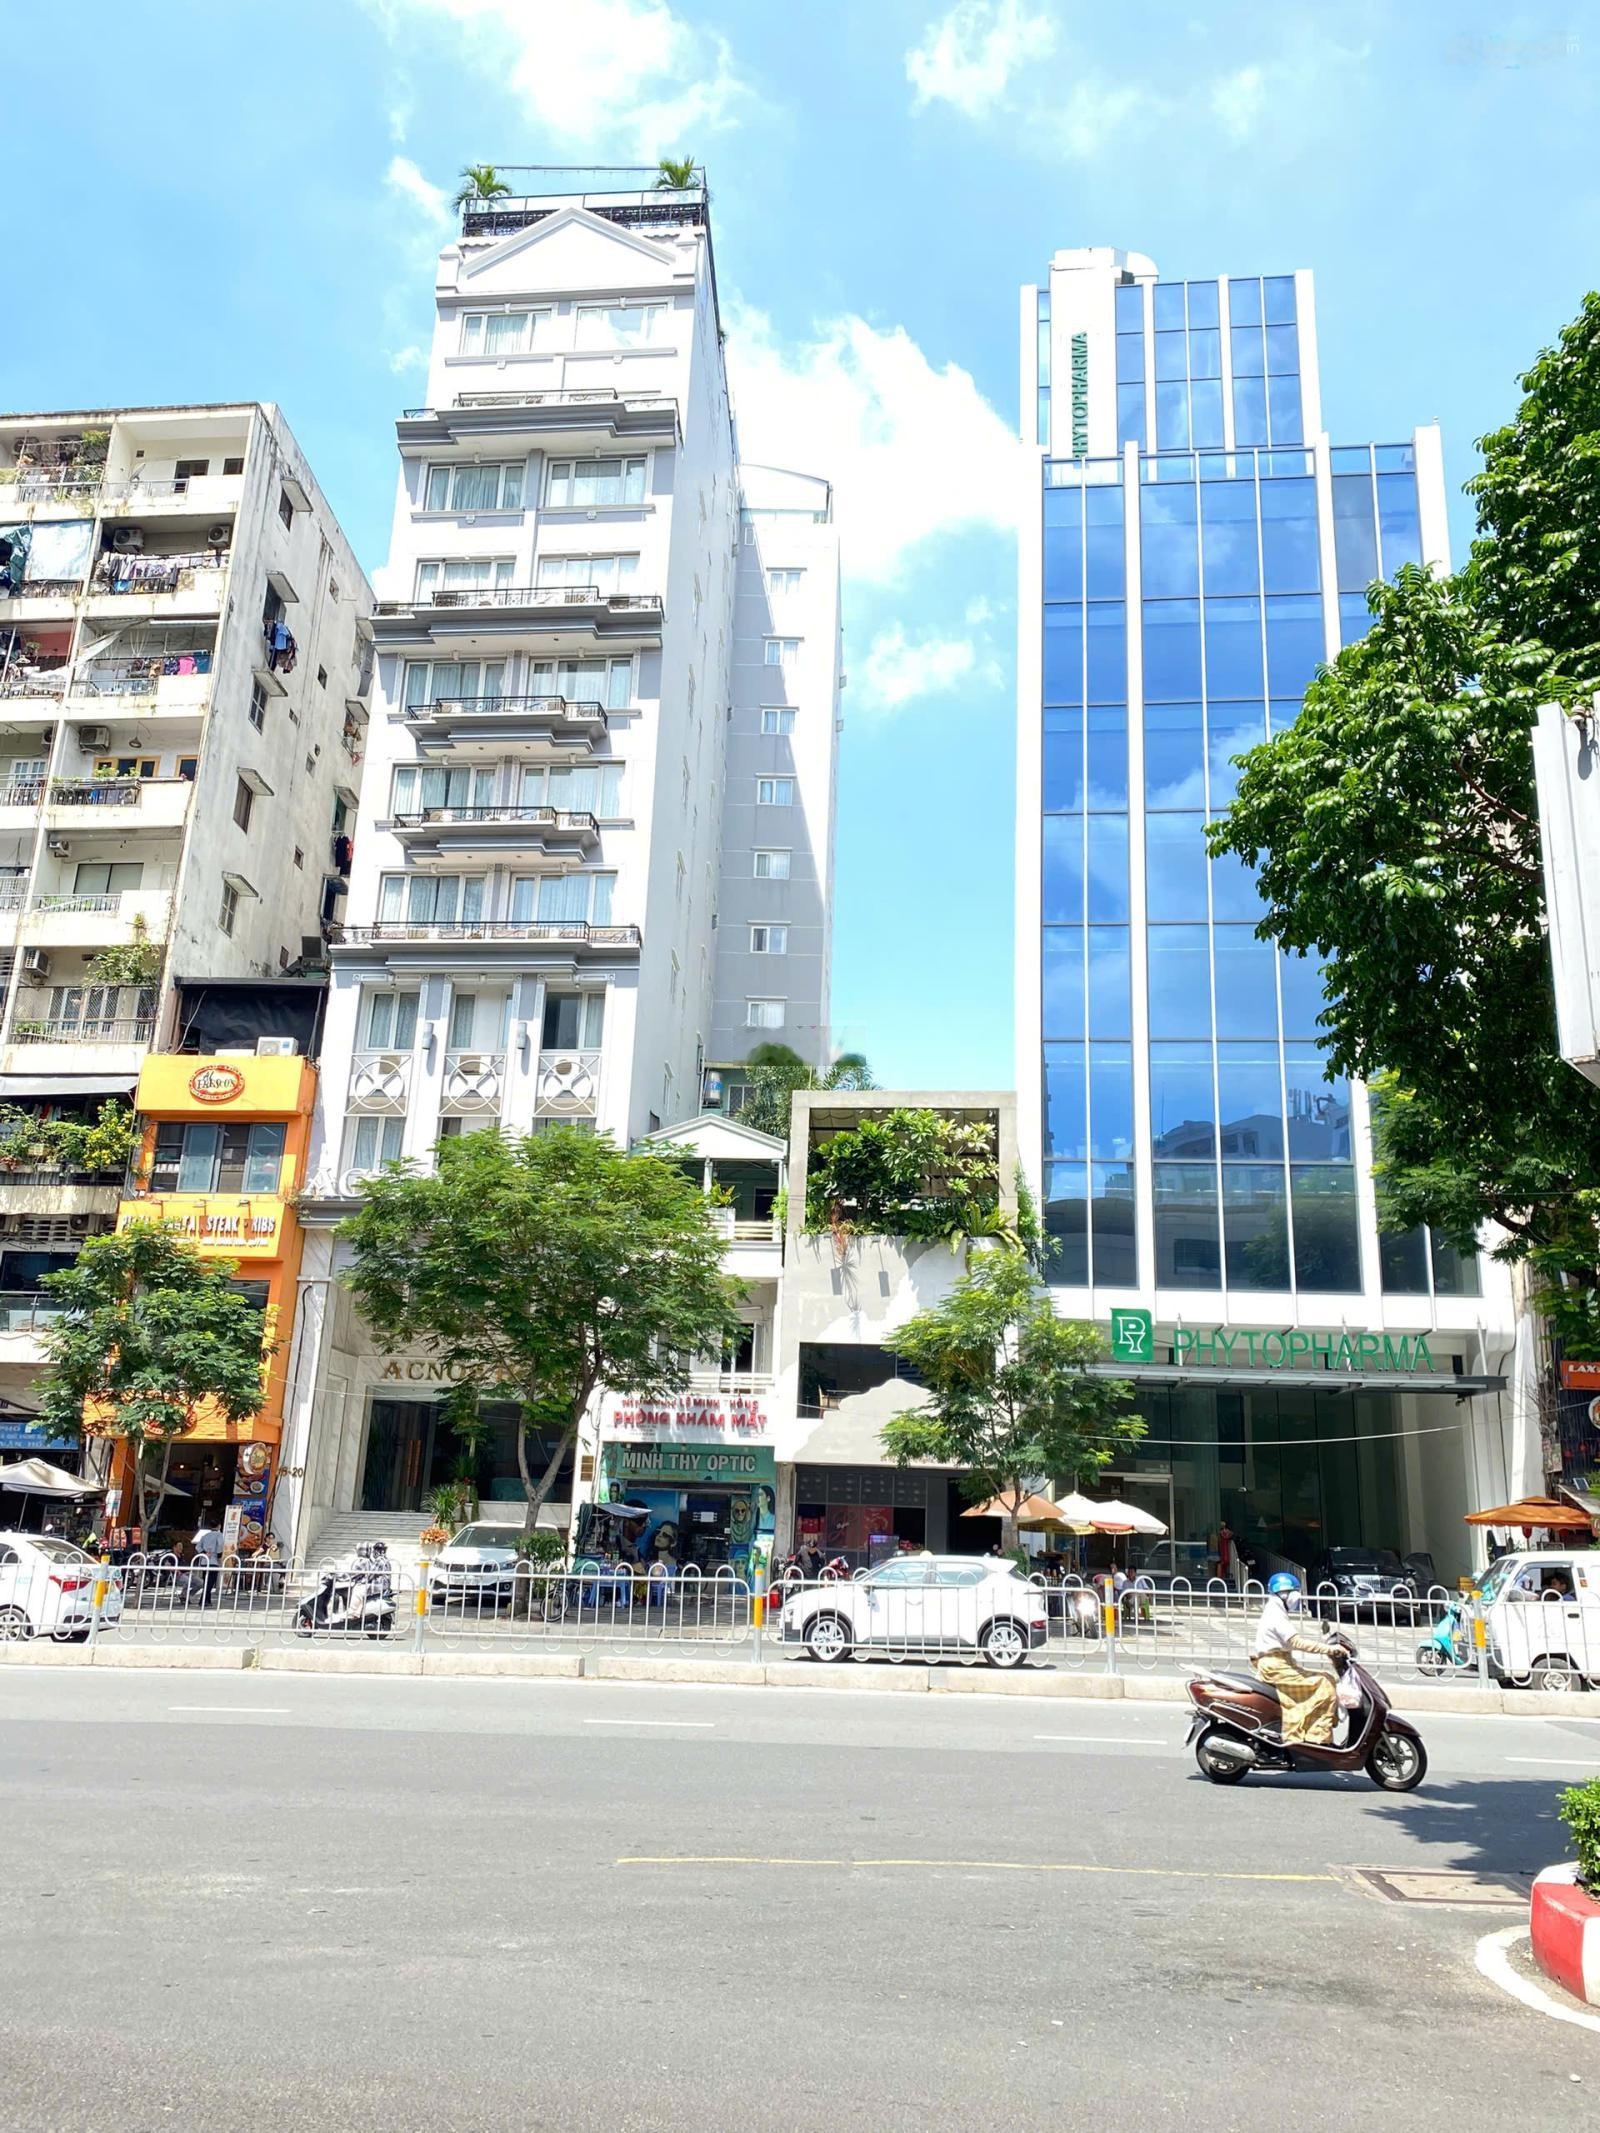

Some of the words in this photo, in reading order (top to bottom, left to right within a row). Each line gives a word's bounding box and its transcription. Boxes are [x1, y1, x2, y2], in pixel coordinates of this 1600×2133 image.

[1071, 332, 1088, 460] PHYTOPHARMA
[206, 1216, 241, 1233] STEAK
[252, 1216, 276, 1233] RIBS
[1174, 1329, 1435, 1372] PHYTOPHARMA
[614, 1408, 671, 1426] PHÒNG
[676, 1409, 725, 1427] KHÁM
[622, 1452, 663, 1470] MINH
[669, 1453, 701, 1470] THY
[707, 1455, 756, 1473] OPTIC
